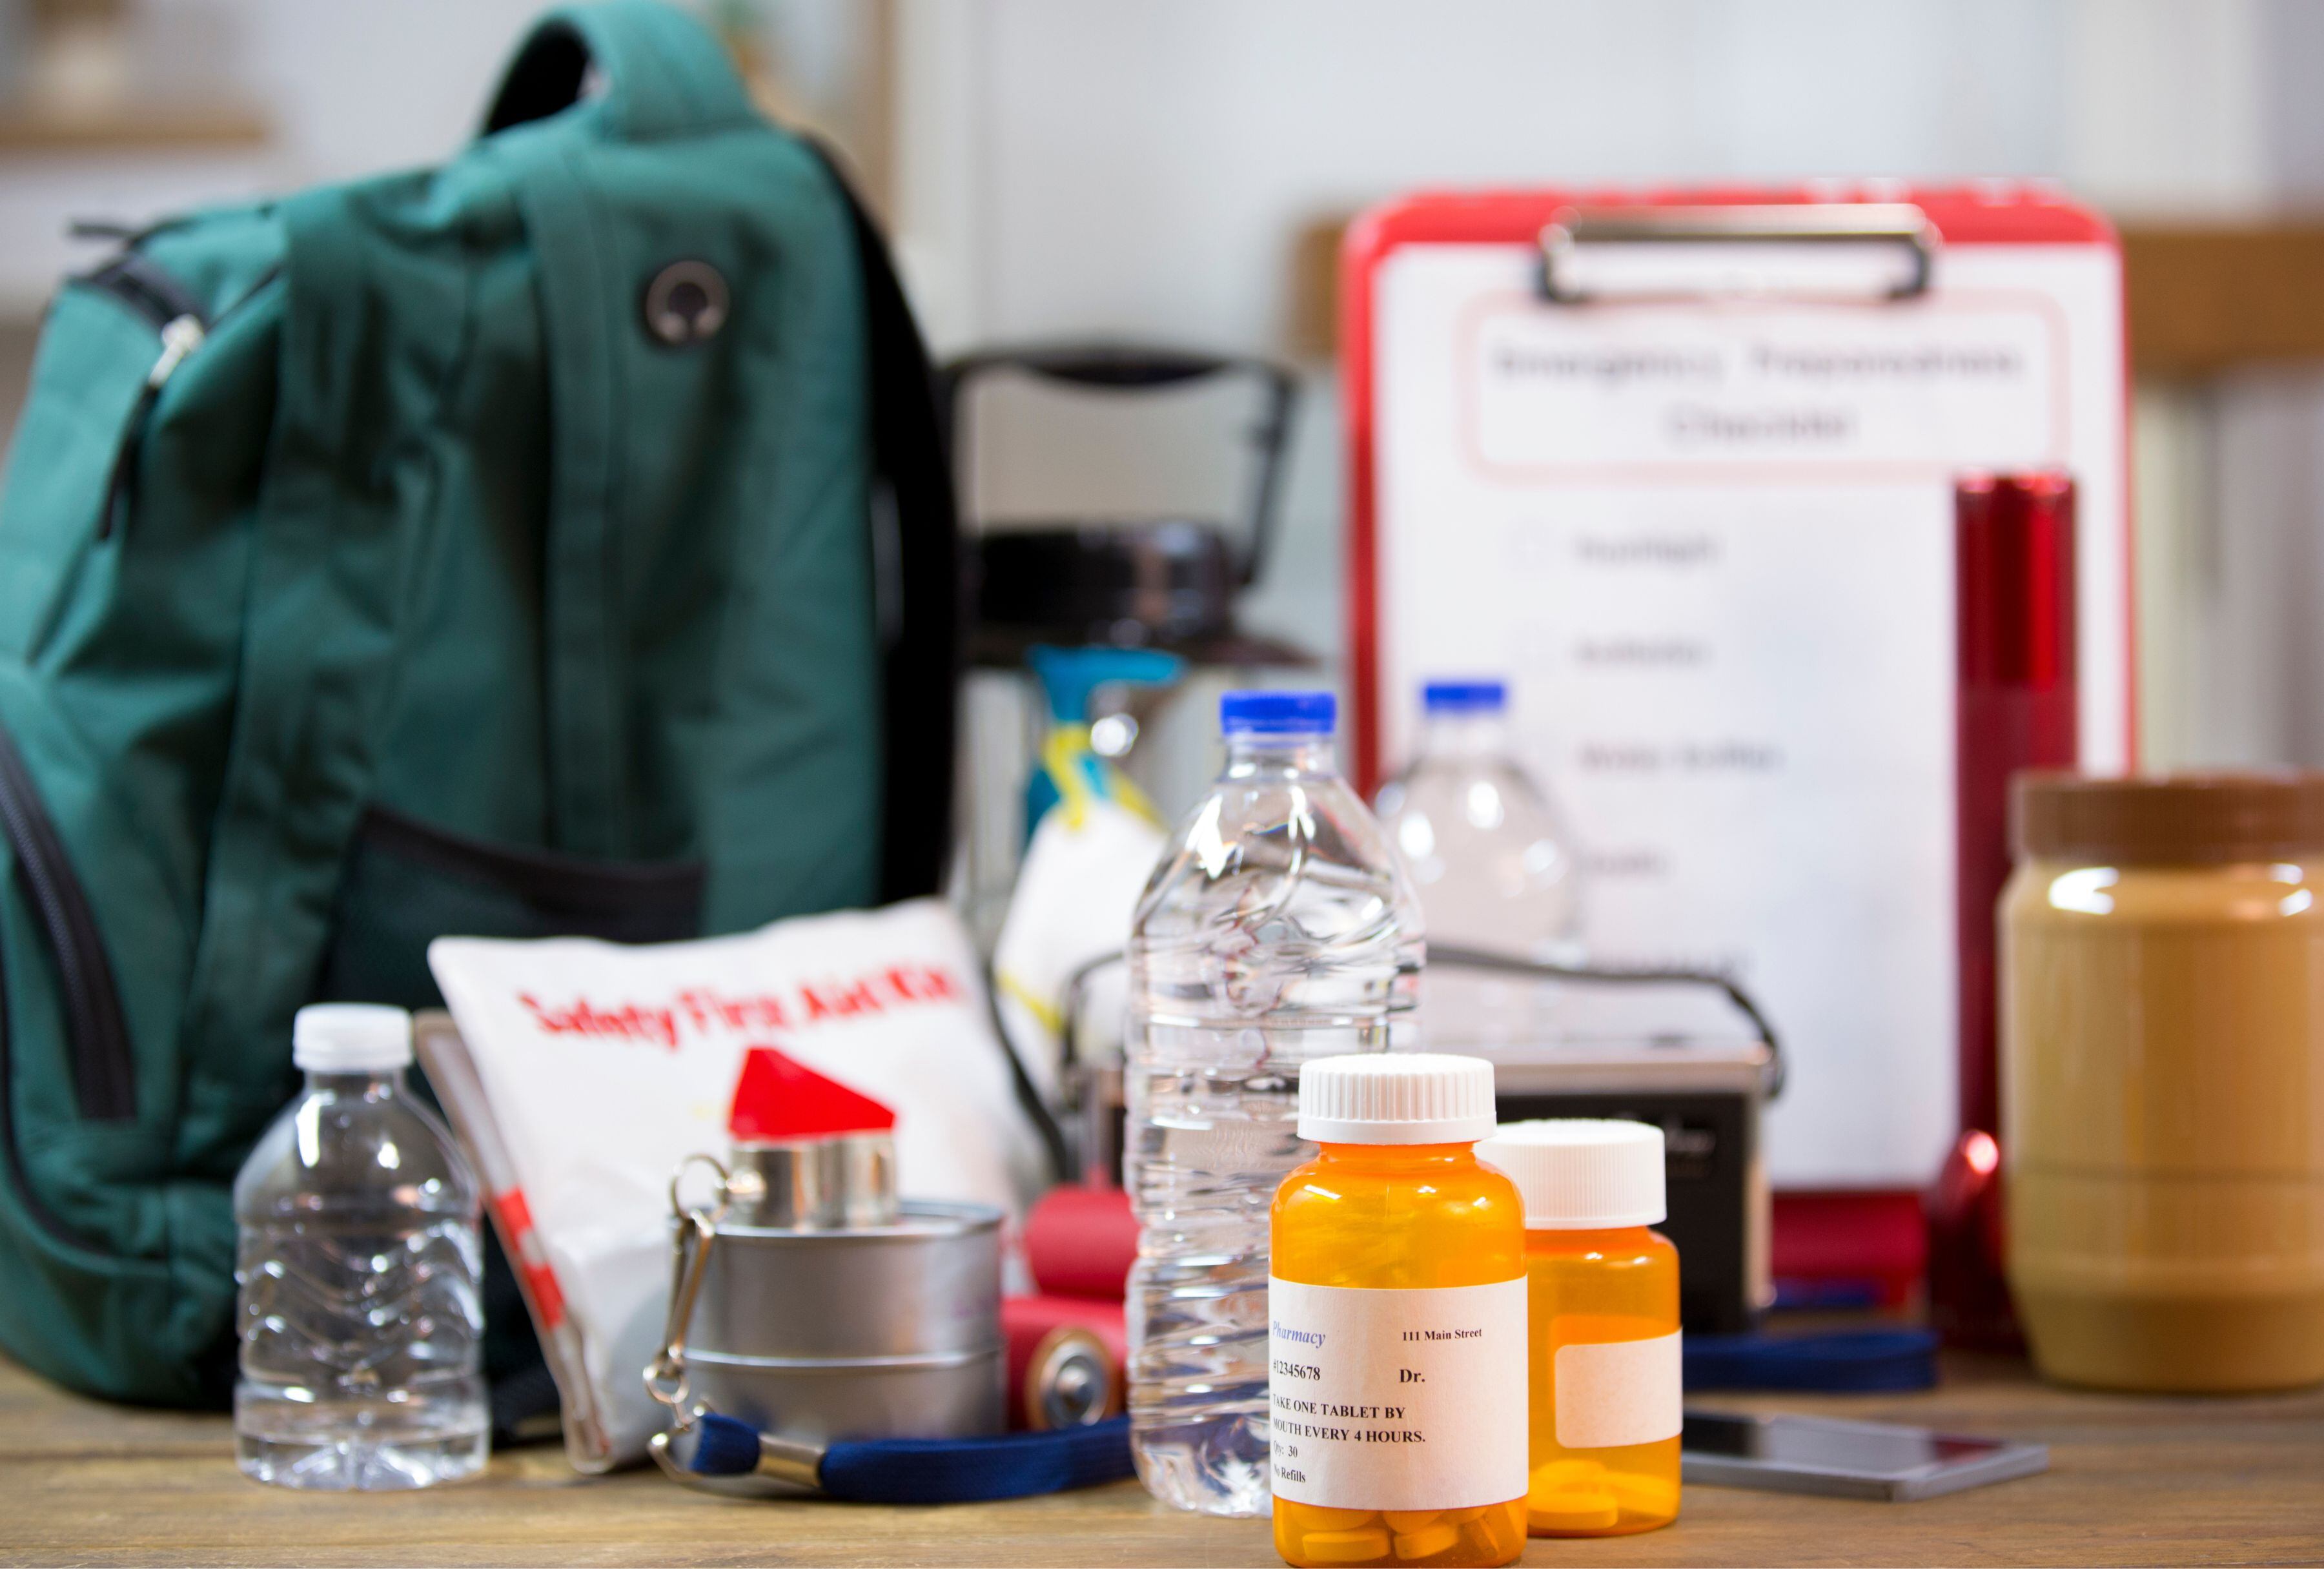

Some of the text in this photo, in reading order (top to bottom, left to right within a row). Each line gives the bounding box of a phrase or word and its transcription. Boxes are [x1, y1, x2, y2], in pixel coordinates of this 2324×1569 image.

[516, 988, 678, 1052] Safety
[1272, 1320, 1326, 1349] Pharmacy
[1402, 1328, 1482, 1341] 111 Main Street
[1273, 1359, 1321, 1381] #12345678
[1399, 1368, 1426, 1383] Dr.
[1272, 1393, 1406, 1419] TAKE ONE TABLET BY
[1273, 1417, 1425, 1443] MOUTH EVERY 4 HOURS.
[1288, 1445, 1298, 1459] 30
[1281, 1467, 1306, 1484] Refills
